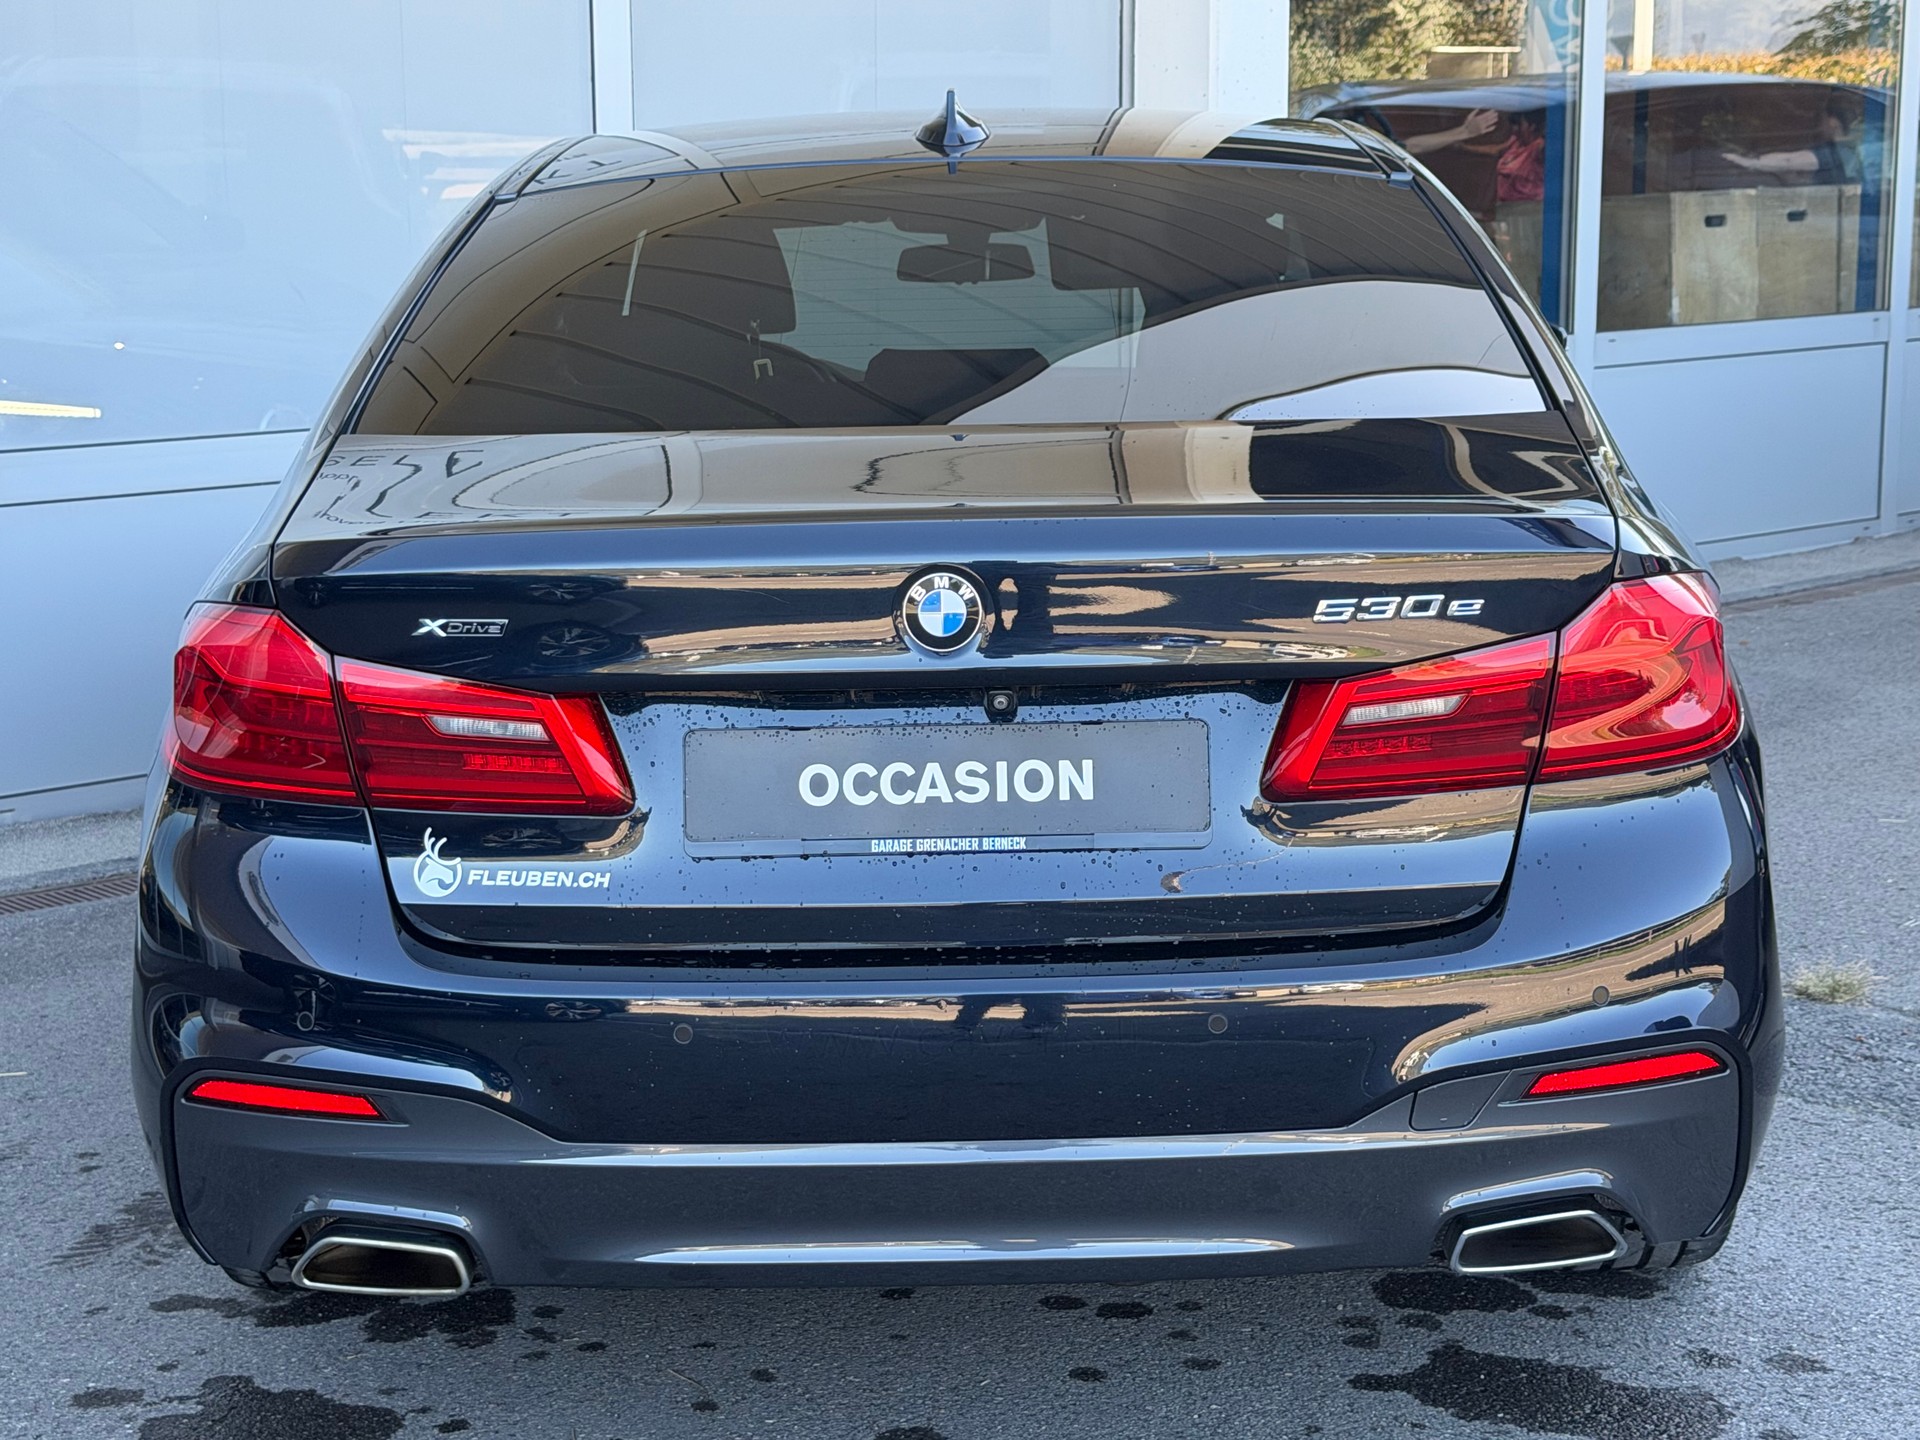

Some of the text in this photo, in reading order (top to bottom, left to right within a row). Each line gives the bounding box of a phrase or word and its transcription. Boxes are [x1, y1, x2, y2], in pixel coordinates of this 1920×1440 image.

[910, 576, 975, 601] BMW
[1313, 594, 1485, 623] 530e
[798, 759, 1094, 807] OCCASION
[871, 836, 1027, 853] GARAGE GRENACHER BERNECK
[467, 869, 611, 888] FLEUBEN.CH
